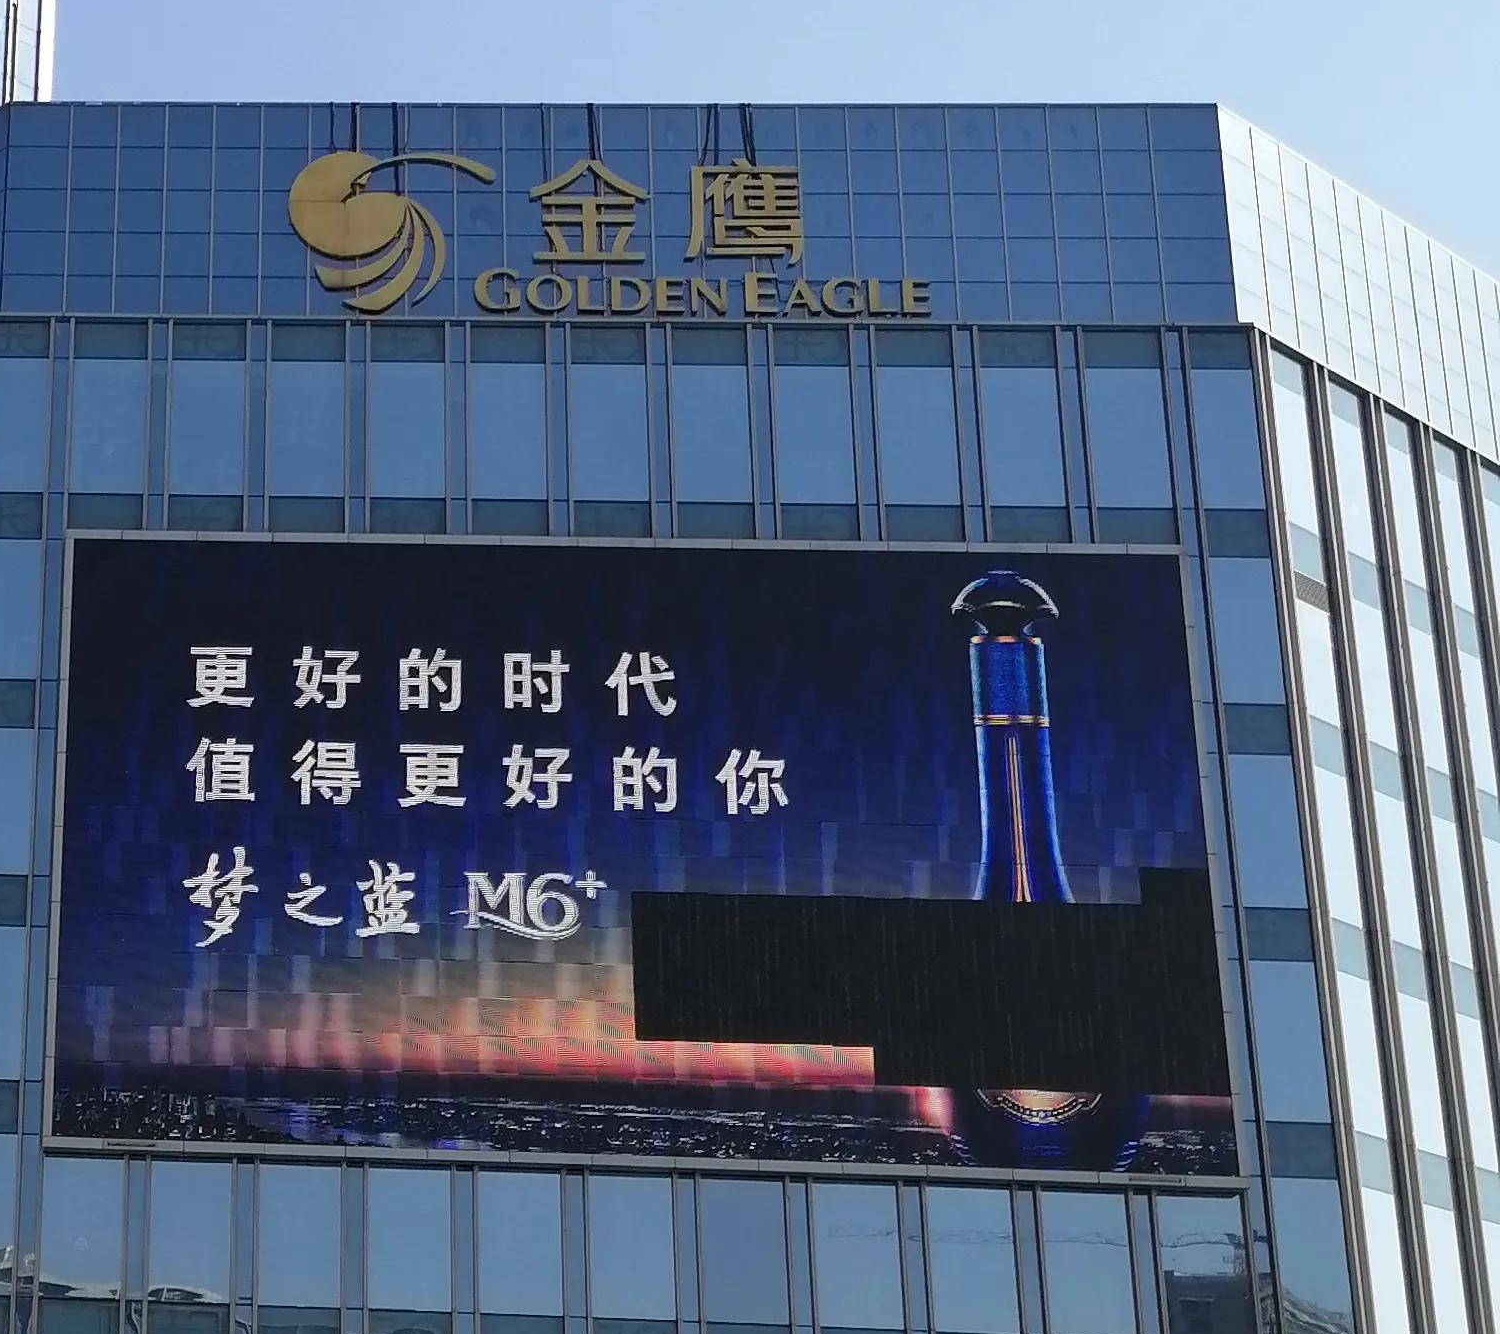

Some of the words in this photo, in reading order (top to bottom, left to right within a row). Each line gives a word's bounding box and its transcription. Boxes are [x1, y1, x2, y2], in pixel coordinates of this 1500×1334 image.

[530, 158, 803, 267] 金鹰
[473, 268, 727, 315] GOLDEN
[744, 272, 932, 318] EAGLE
[186, 644, 678, 717] 更好的时代
[185, 736, 789, 816] 值得更好的你
[183, 845, 421, 948] 梦之蓝
